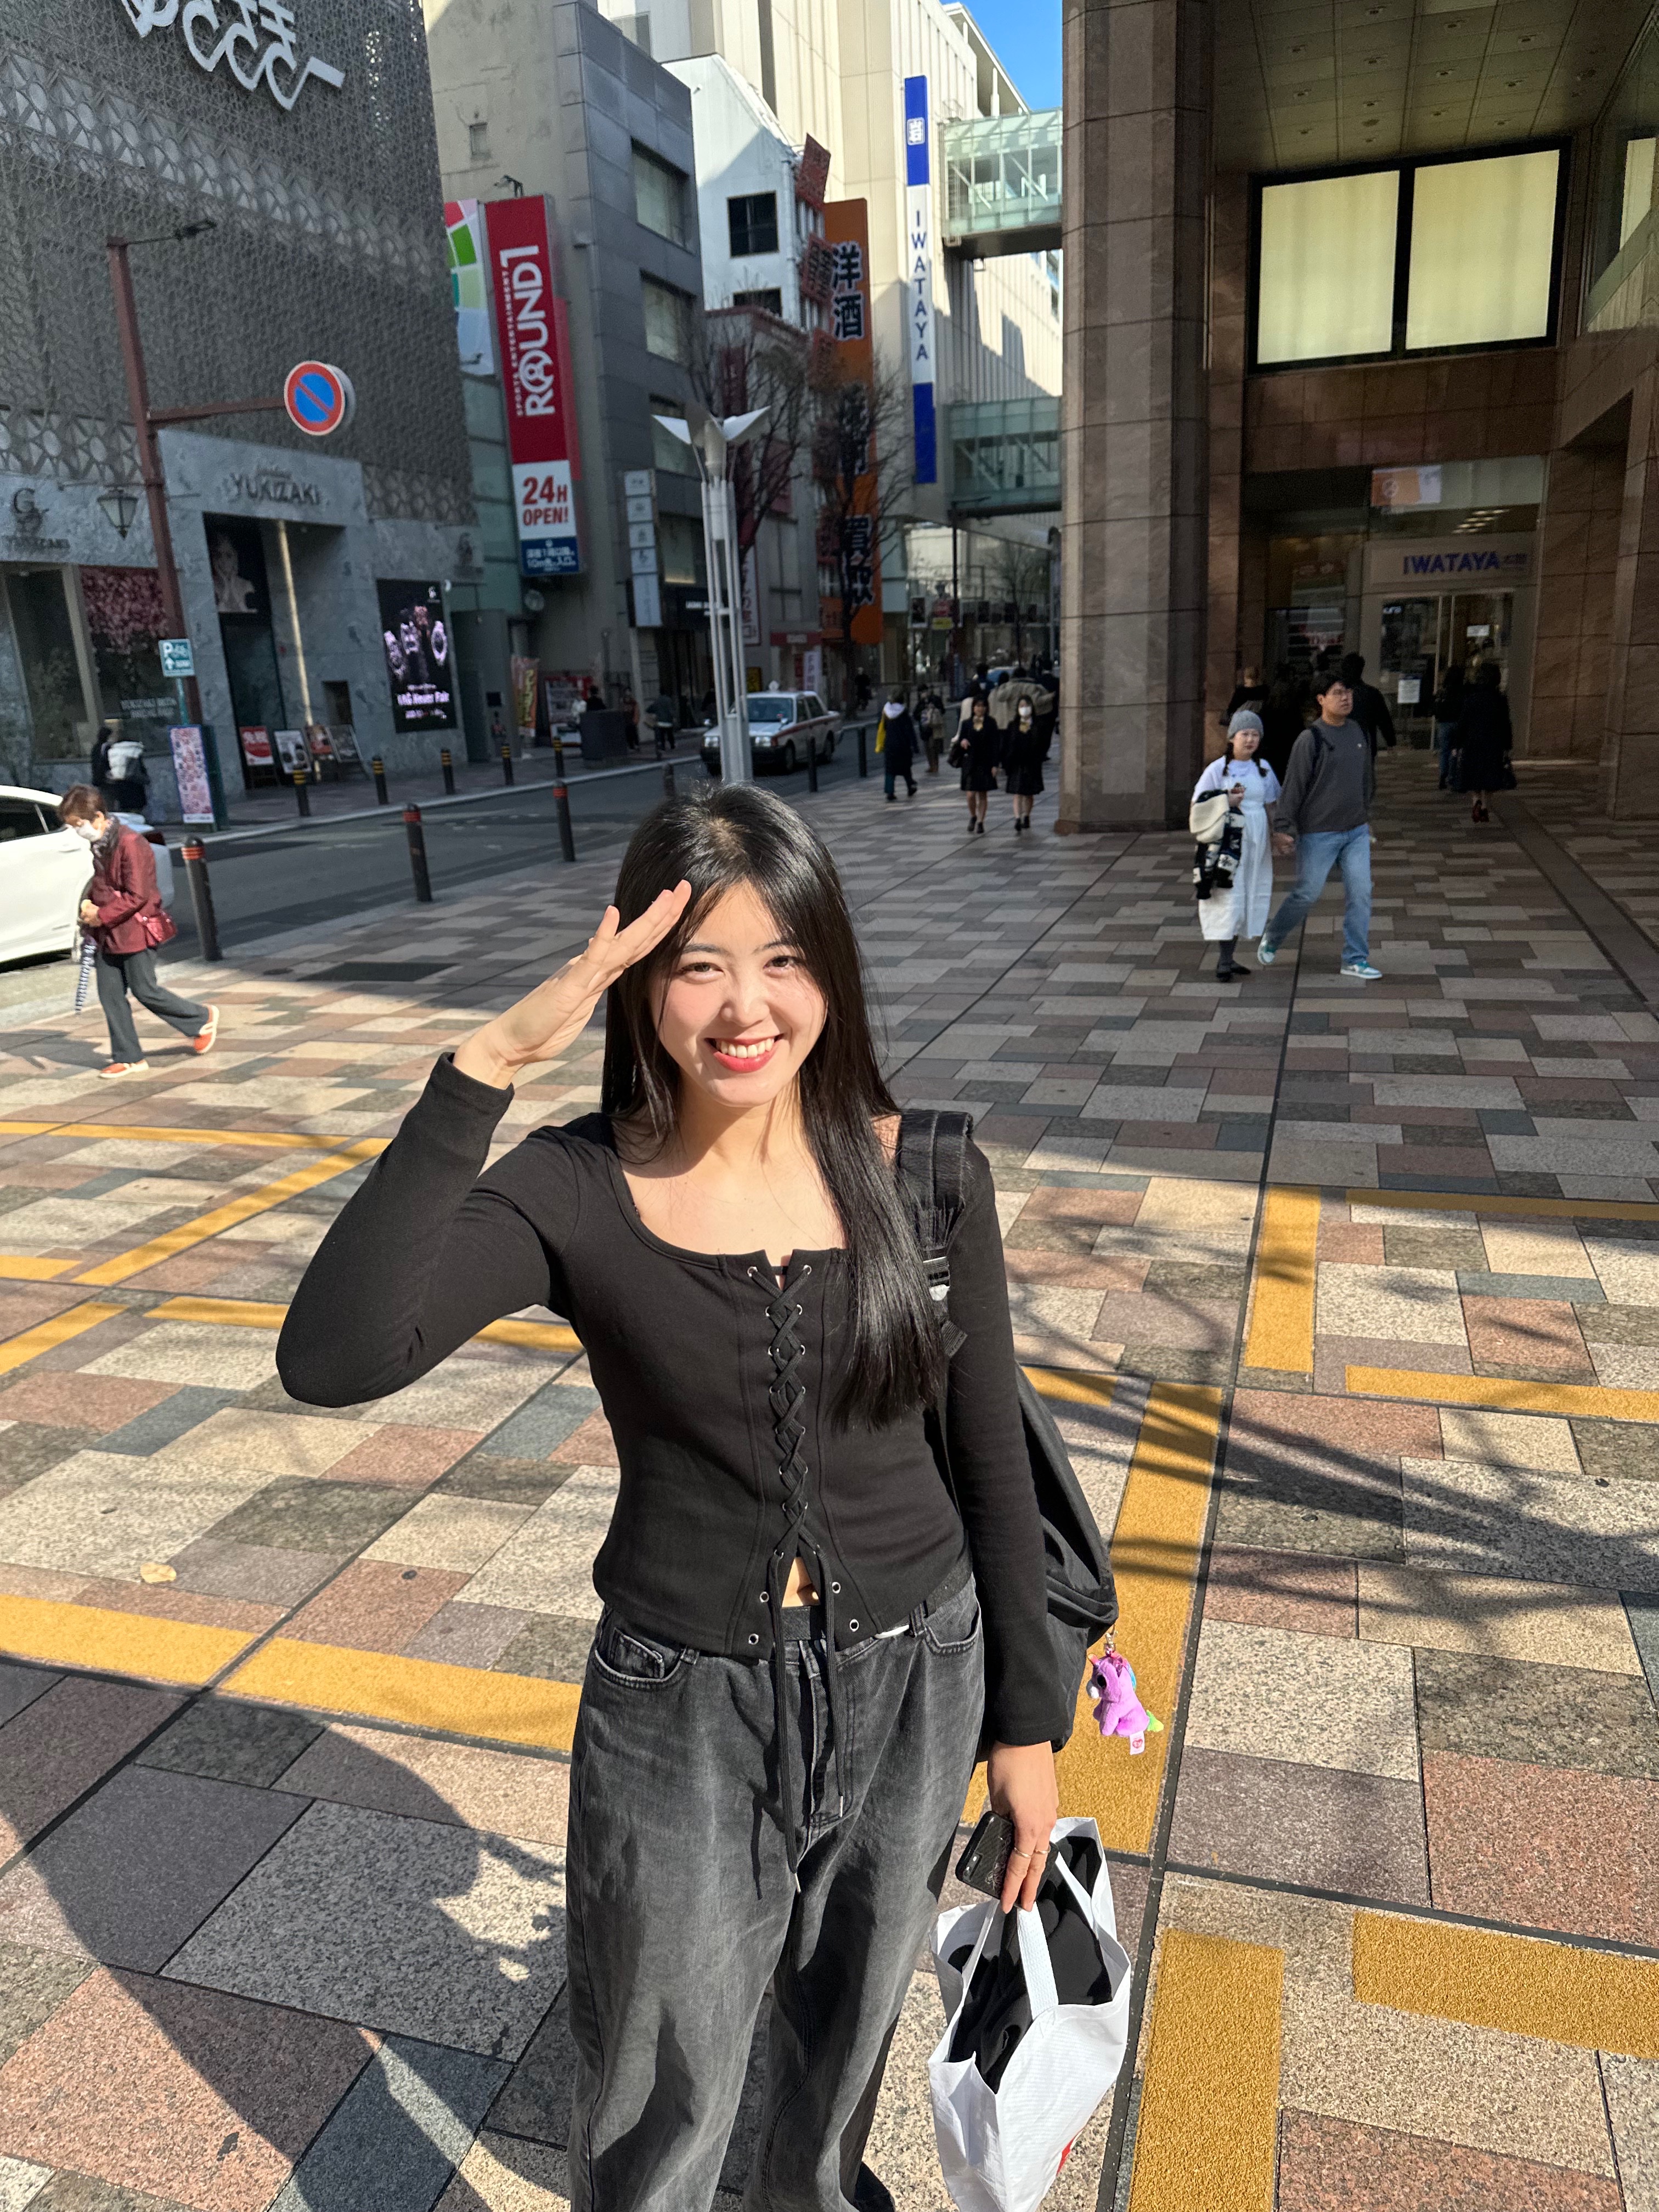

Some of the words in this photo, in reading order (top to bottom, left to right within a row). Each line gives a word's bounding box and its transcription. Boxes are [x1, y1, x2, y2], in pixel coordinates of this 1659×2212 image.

[832, 244, 863, 339] 洋酒
[911, 210, 929, 361] IWATAYA
[500, 245, 556, 416] ROUND1
[523, 475, 567, 504] 24H
[523, 507, 568, 526] OPEN!
[1403, 551, 1499, 574] IWATAYA
